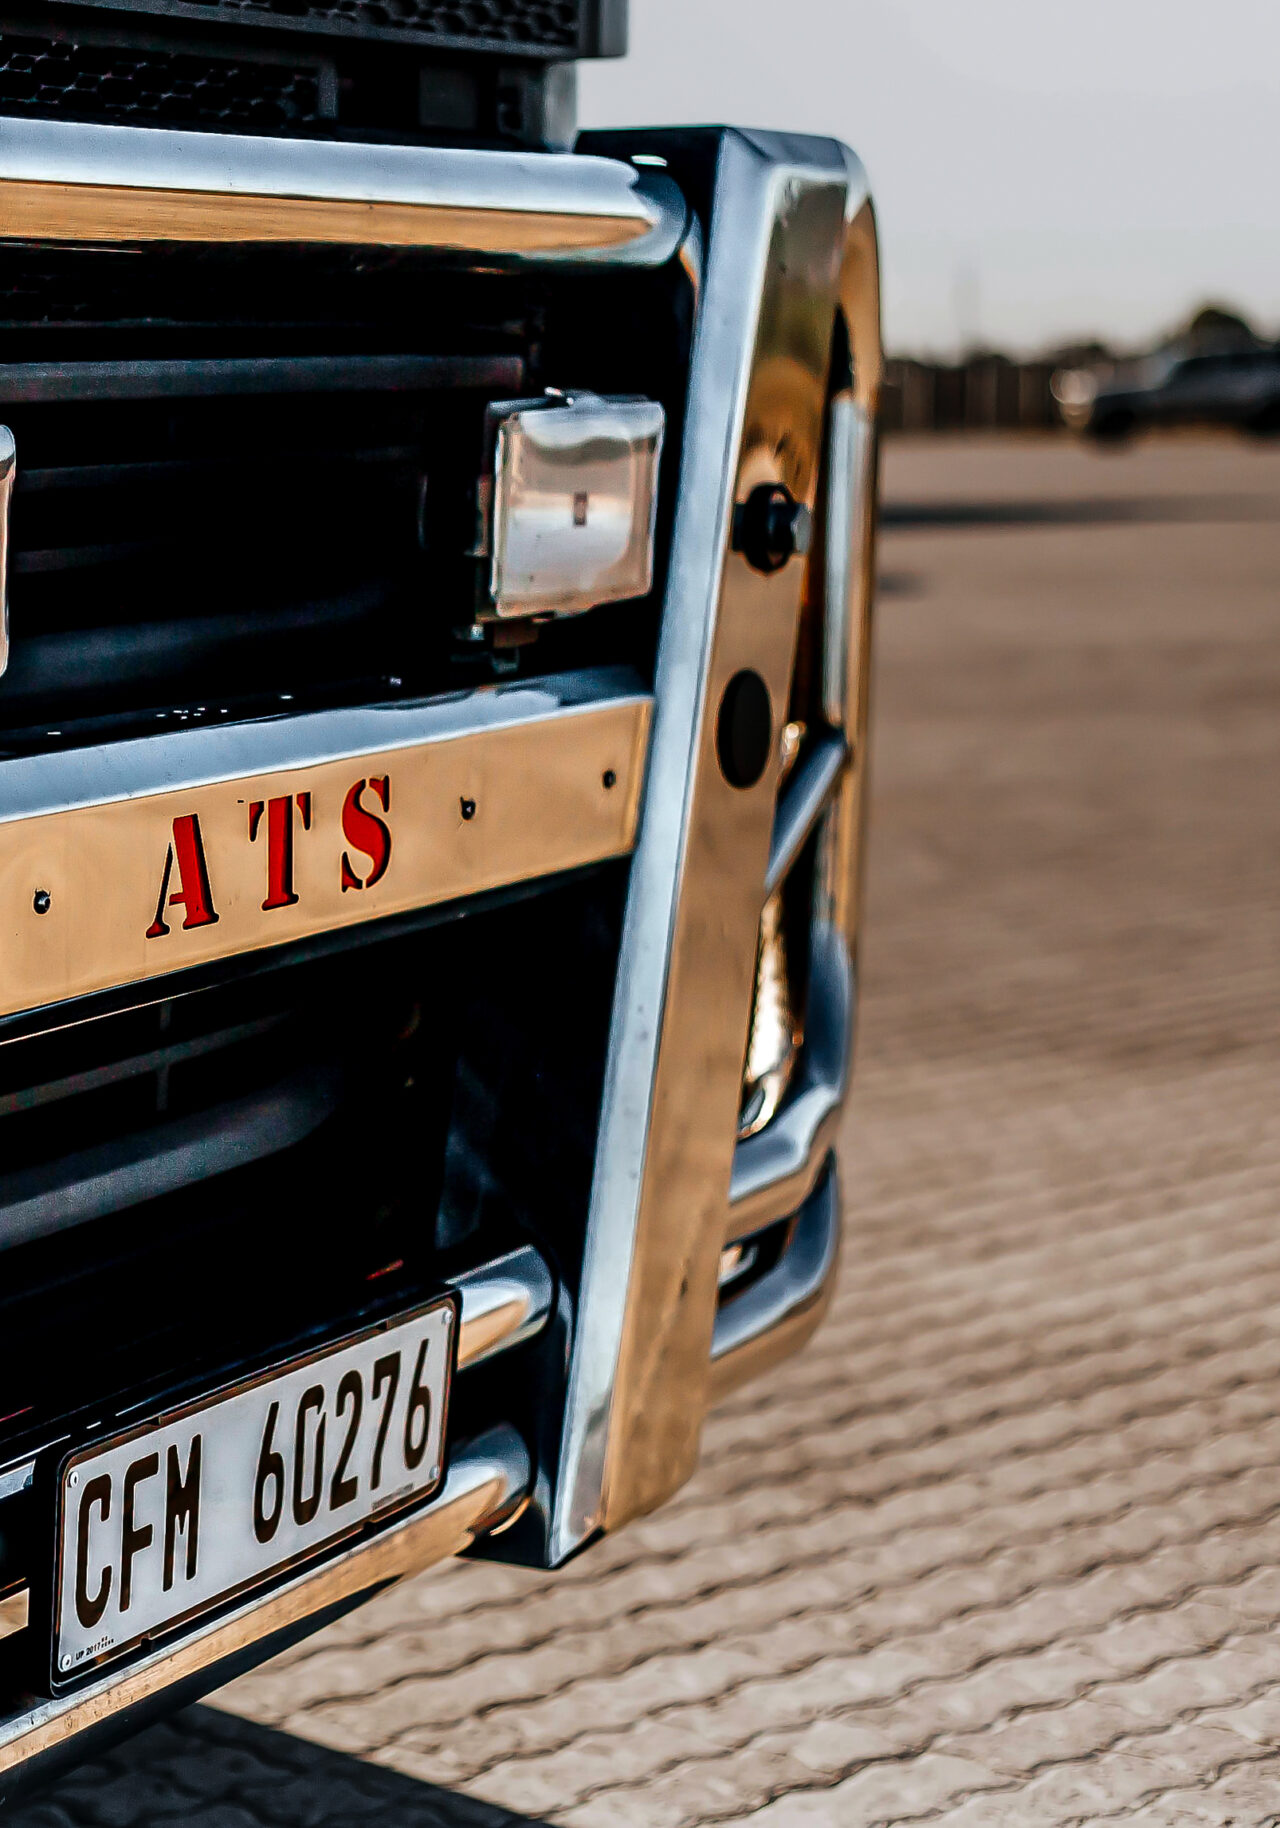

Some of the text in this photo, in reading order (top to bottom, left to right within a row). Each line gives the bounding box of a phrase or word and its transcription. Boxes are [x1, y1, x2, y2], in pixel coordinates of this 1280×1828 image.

[145, 775, 392, 939] ATS
[75, 1338, 432, 1629] CFM 60276
[86, 1641, 101, 1656] 2017
